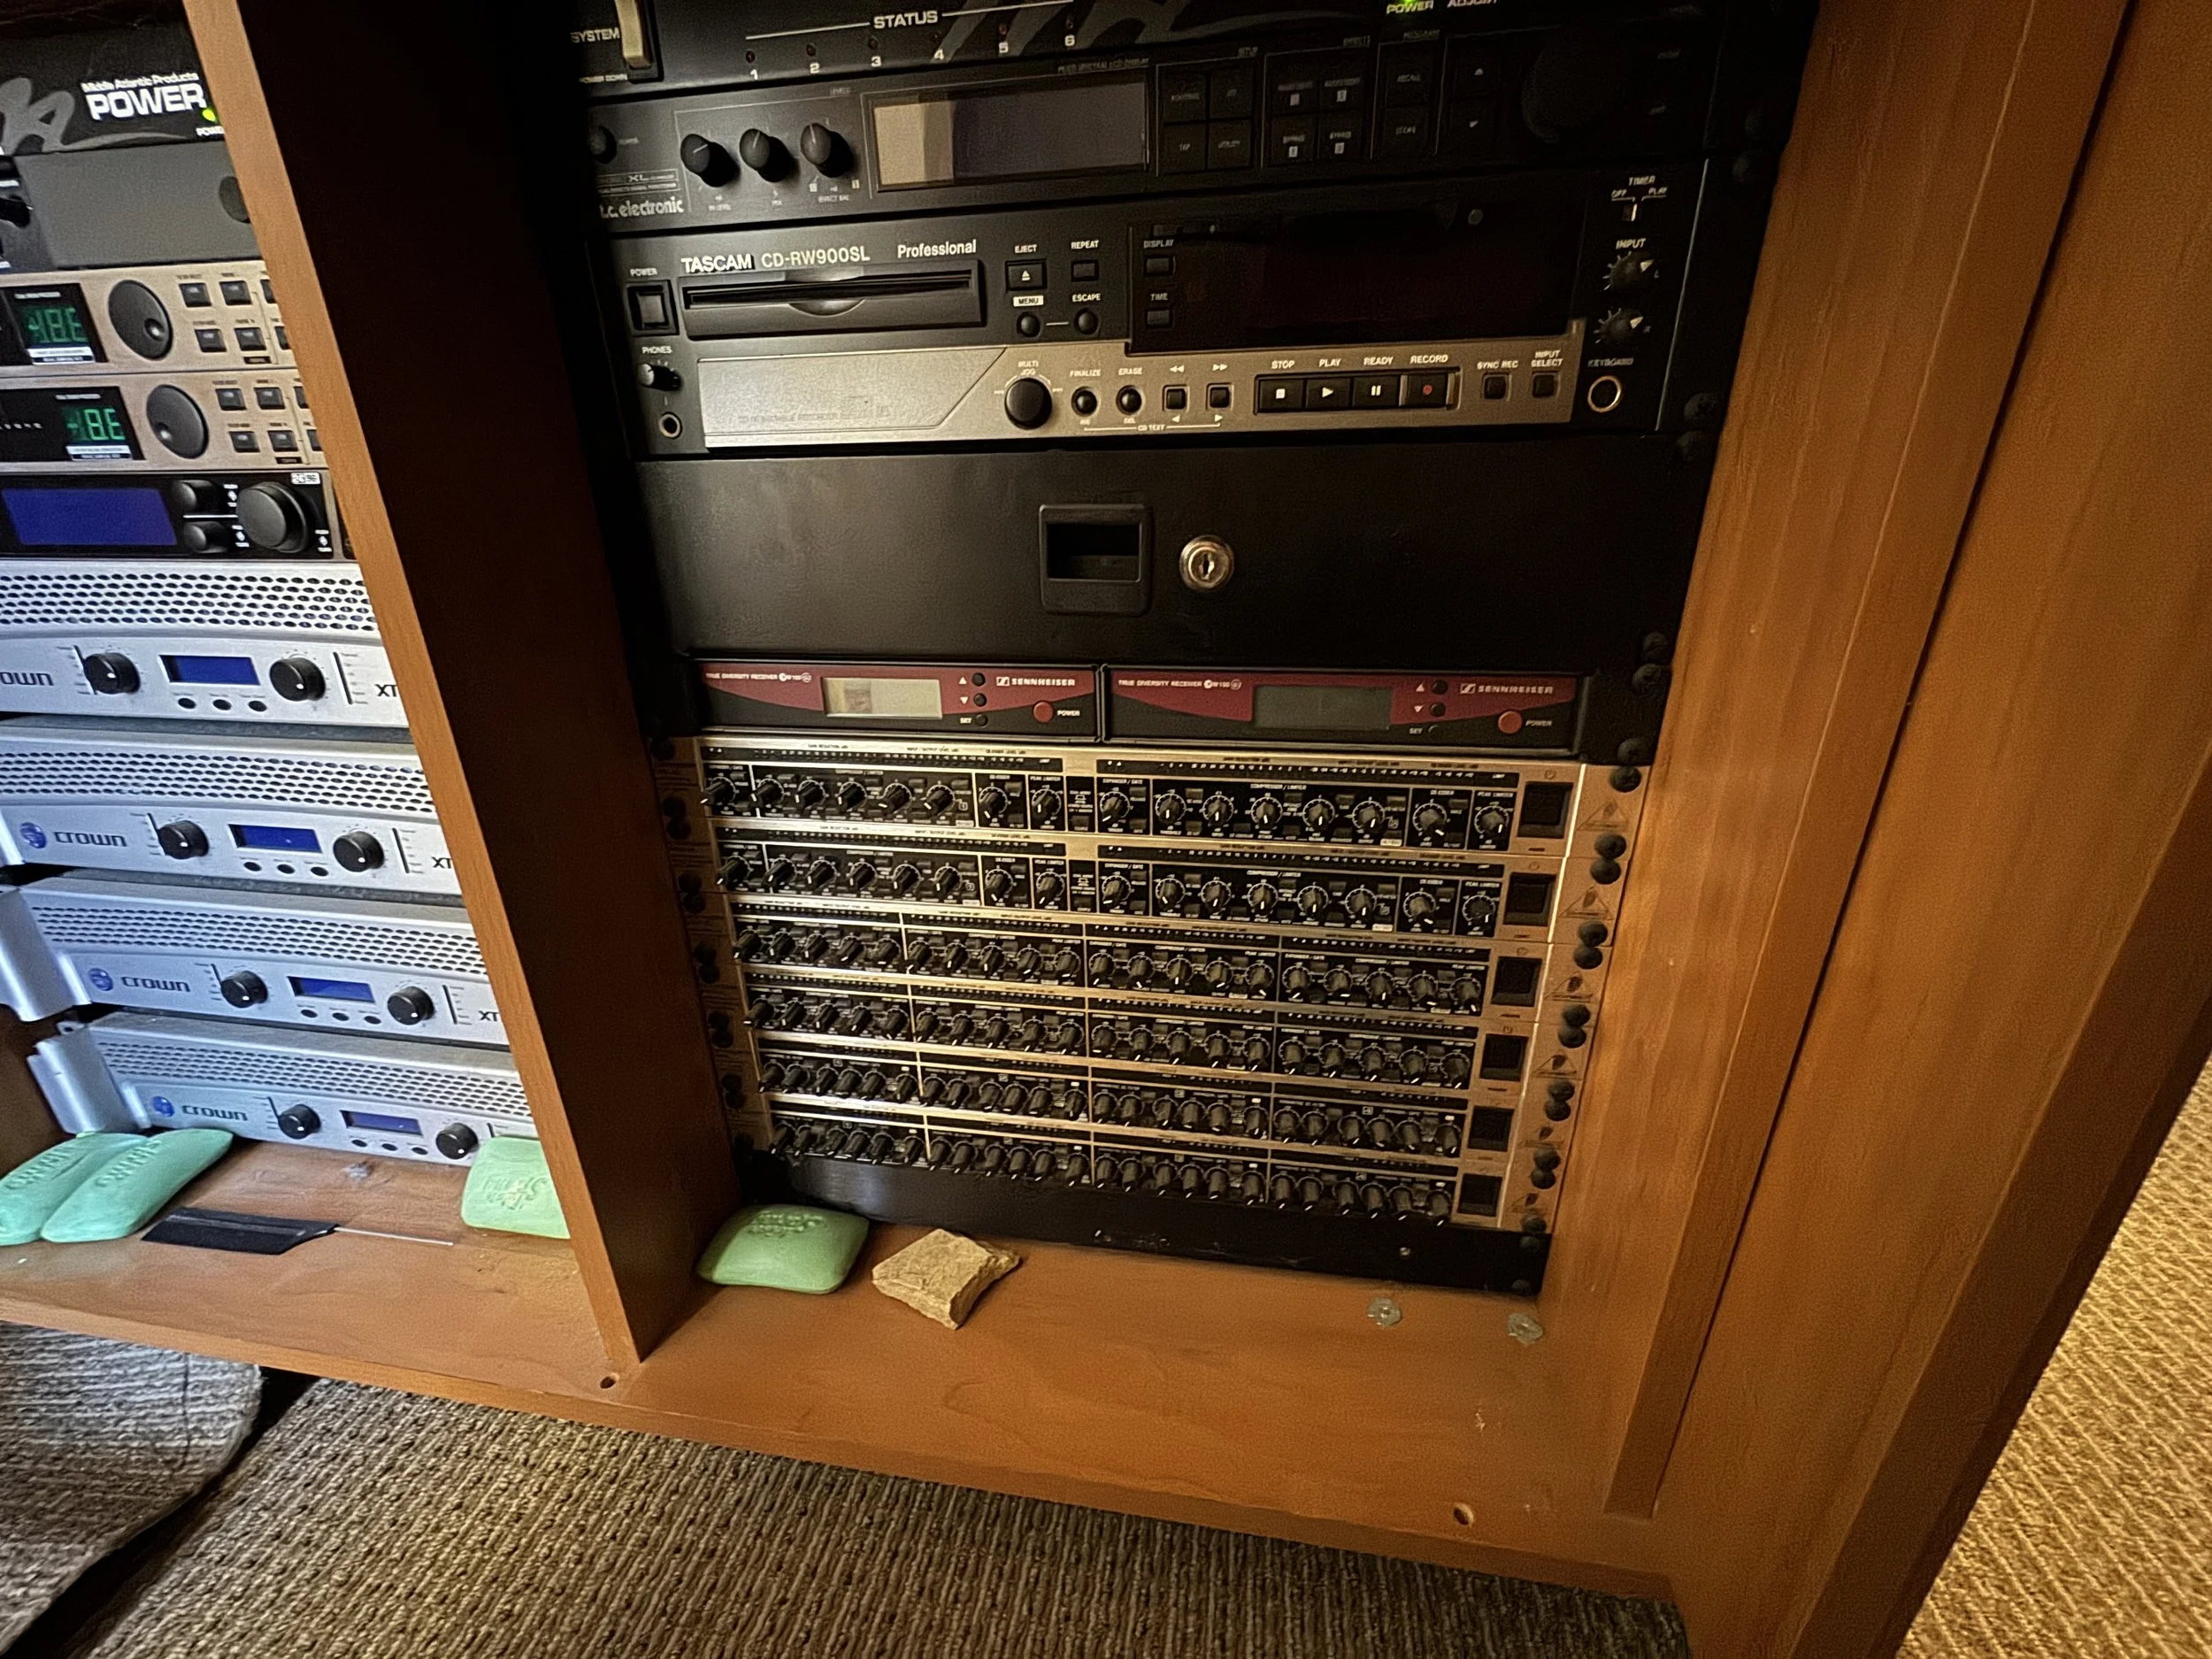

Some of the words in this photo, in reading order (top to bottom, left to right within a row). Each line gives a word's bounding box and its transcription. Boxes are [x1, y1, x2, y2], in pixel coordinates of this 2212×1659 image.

[872, 10, 939, 30] STATUS
[569, 27, 621, 43] SYSTEM
[1064, 34, 1075, 47] 6
[998, 41, 1009, 54] 5
[933, 49, 945, 61] 4
[871, 56, 882, 68] 3
[751, 68, 760, 81] 1
[810, 63, 819, 74] 2
[150, 72, 200, 86] Products
[86, 82, 207, 121] POWER
[618, 196, 685, 219] electronic
[1014, 244, 1039, 254] EJECT
[1071, 240, 1100, 250] REPEAT
[1615, 237, 1647, 249] INPUT
[896, 239, 978, 265] Professional
[680, 252, 754, 274] TASCAM
[761, 244, 872, 269] CD-RW900SL
[629, 268, 658, 278] POWER
[1071, 293, 1102, 303] ESCAPE
[1149, 293, 1169, 302] TIME
[641, 345, 673, 355] PHONES
[1271, 359, 1295, 370] STOP
[1318, 357, 1342, 368] PLAY
[1363, 356, 1394, 366] READY
[1409, 354, 1449, 365] RECORD
[1530, 357, 1563, 368] SELECT
[1011, 676, 1077, 687] SENNHEISER
[1478, 684, 1555, 695] SENNHEISER
[1056, 708, 1081, 718] POWER
[53, 831, 127, 848] crown
[120, 976, 190, 994] crown
[181, 1102, 248, 1121] crown
